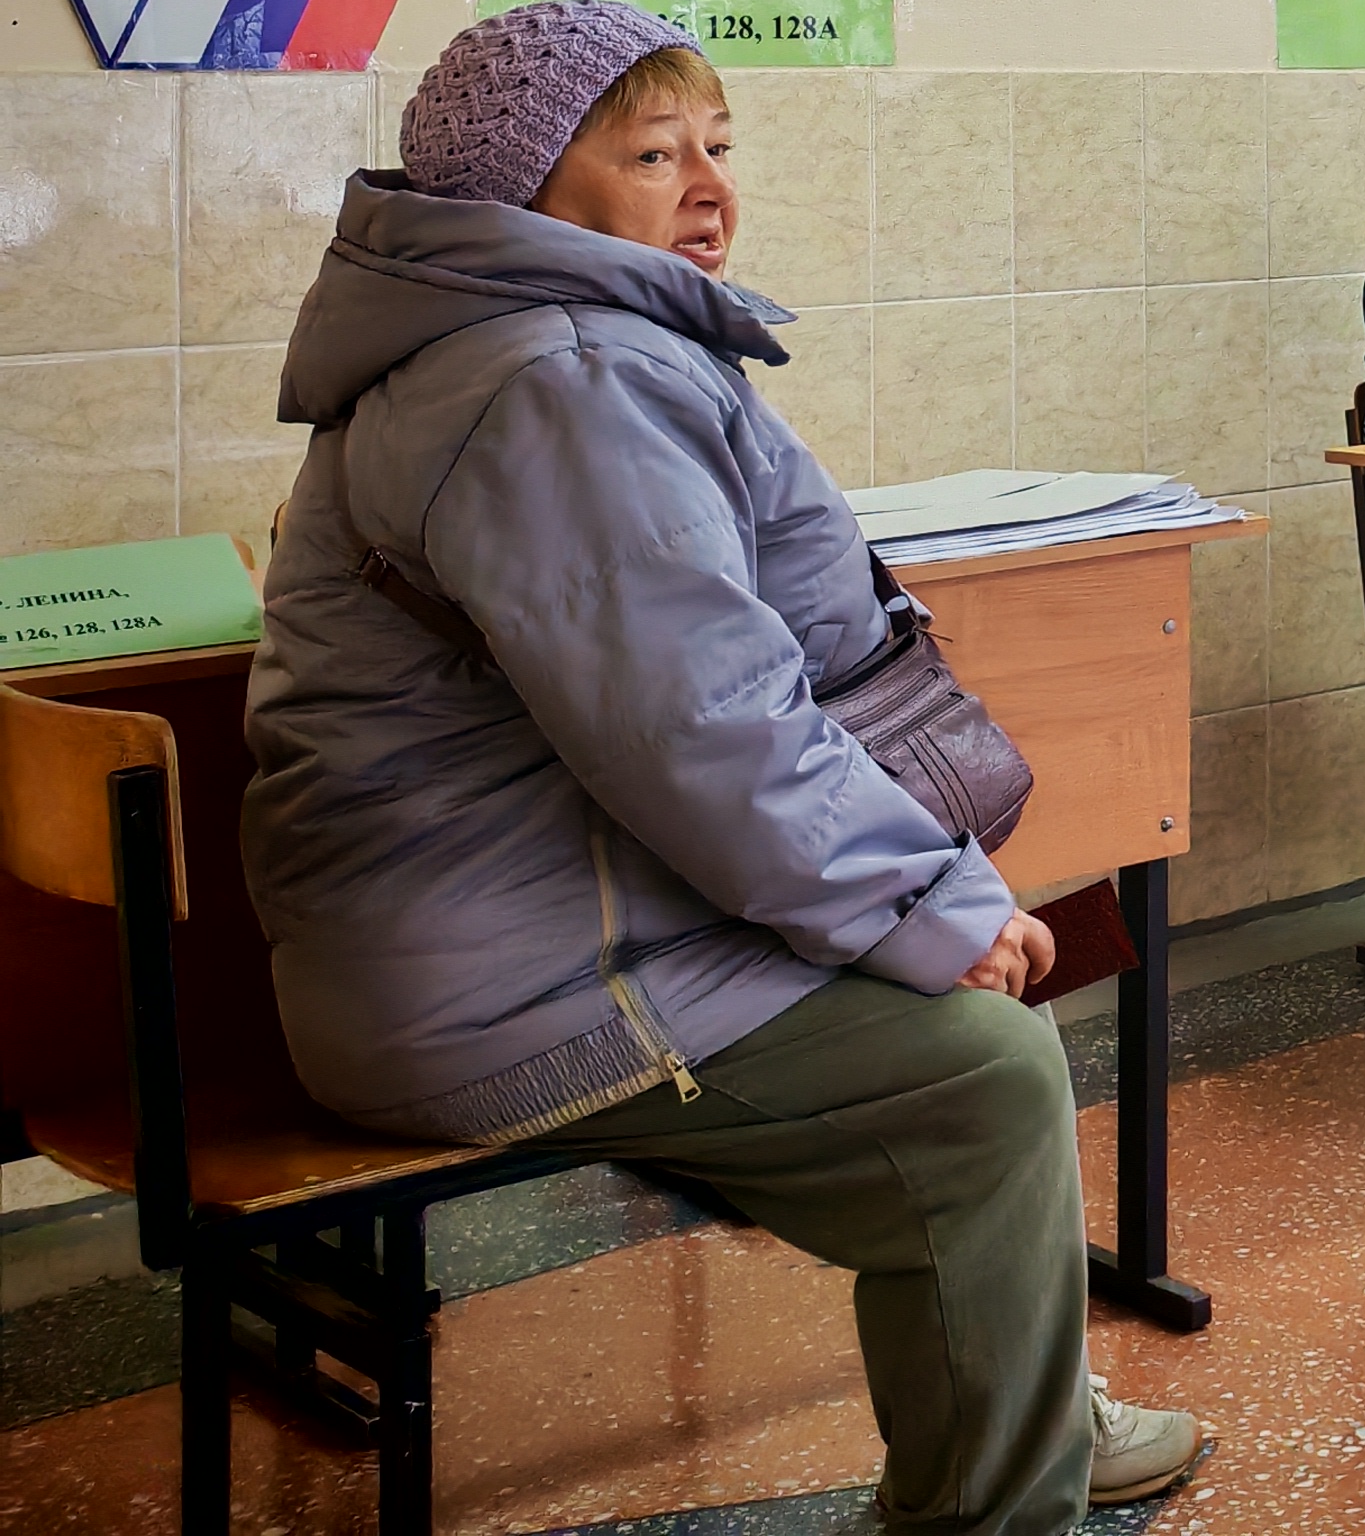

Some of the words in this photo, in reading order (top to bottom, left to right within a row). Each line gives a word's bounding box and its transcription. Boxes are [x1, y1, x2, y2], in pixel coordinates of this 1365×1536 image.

[708, 15, 762, 44] 128,
[773, 15, 839, 39] 128А
[16, 588, 130, 608] ЛЕНИНА,
[15, 627, 58, 642] 126,
[64, 621, 106, 636] 128,
[111, 615, 163, 631] 128А
